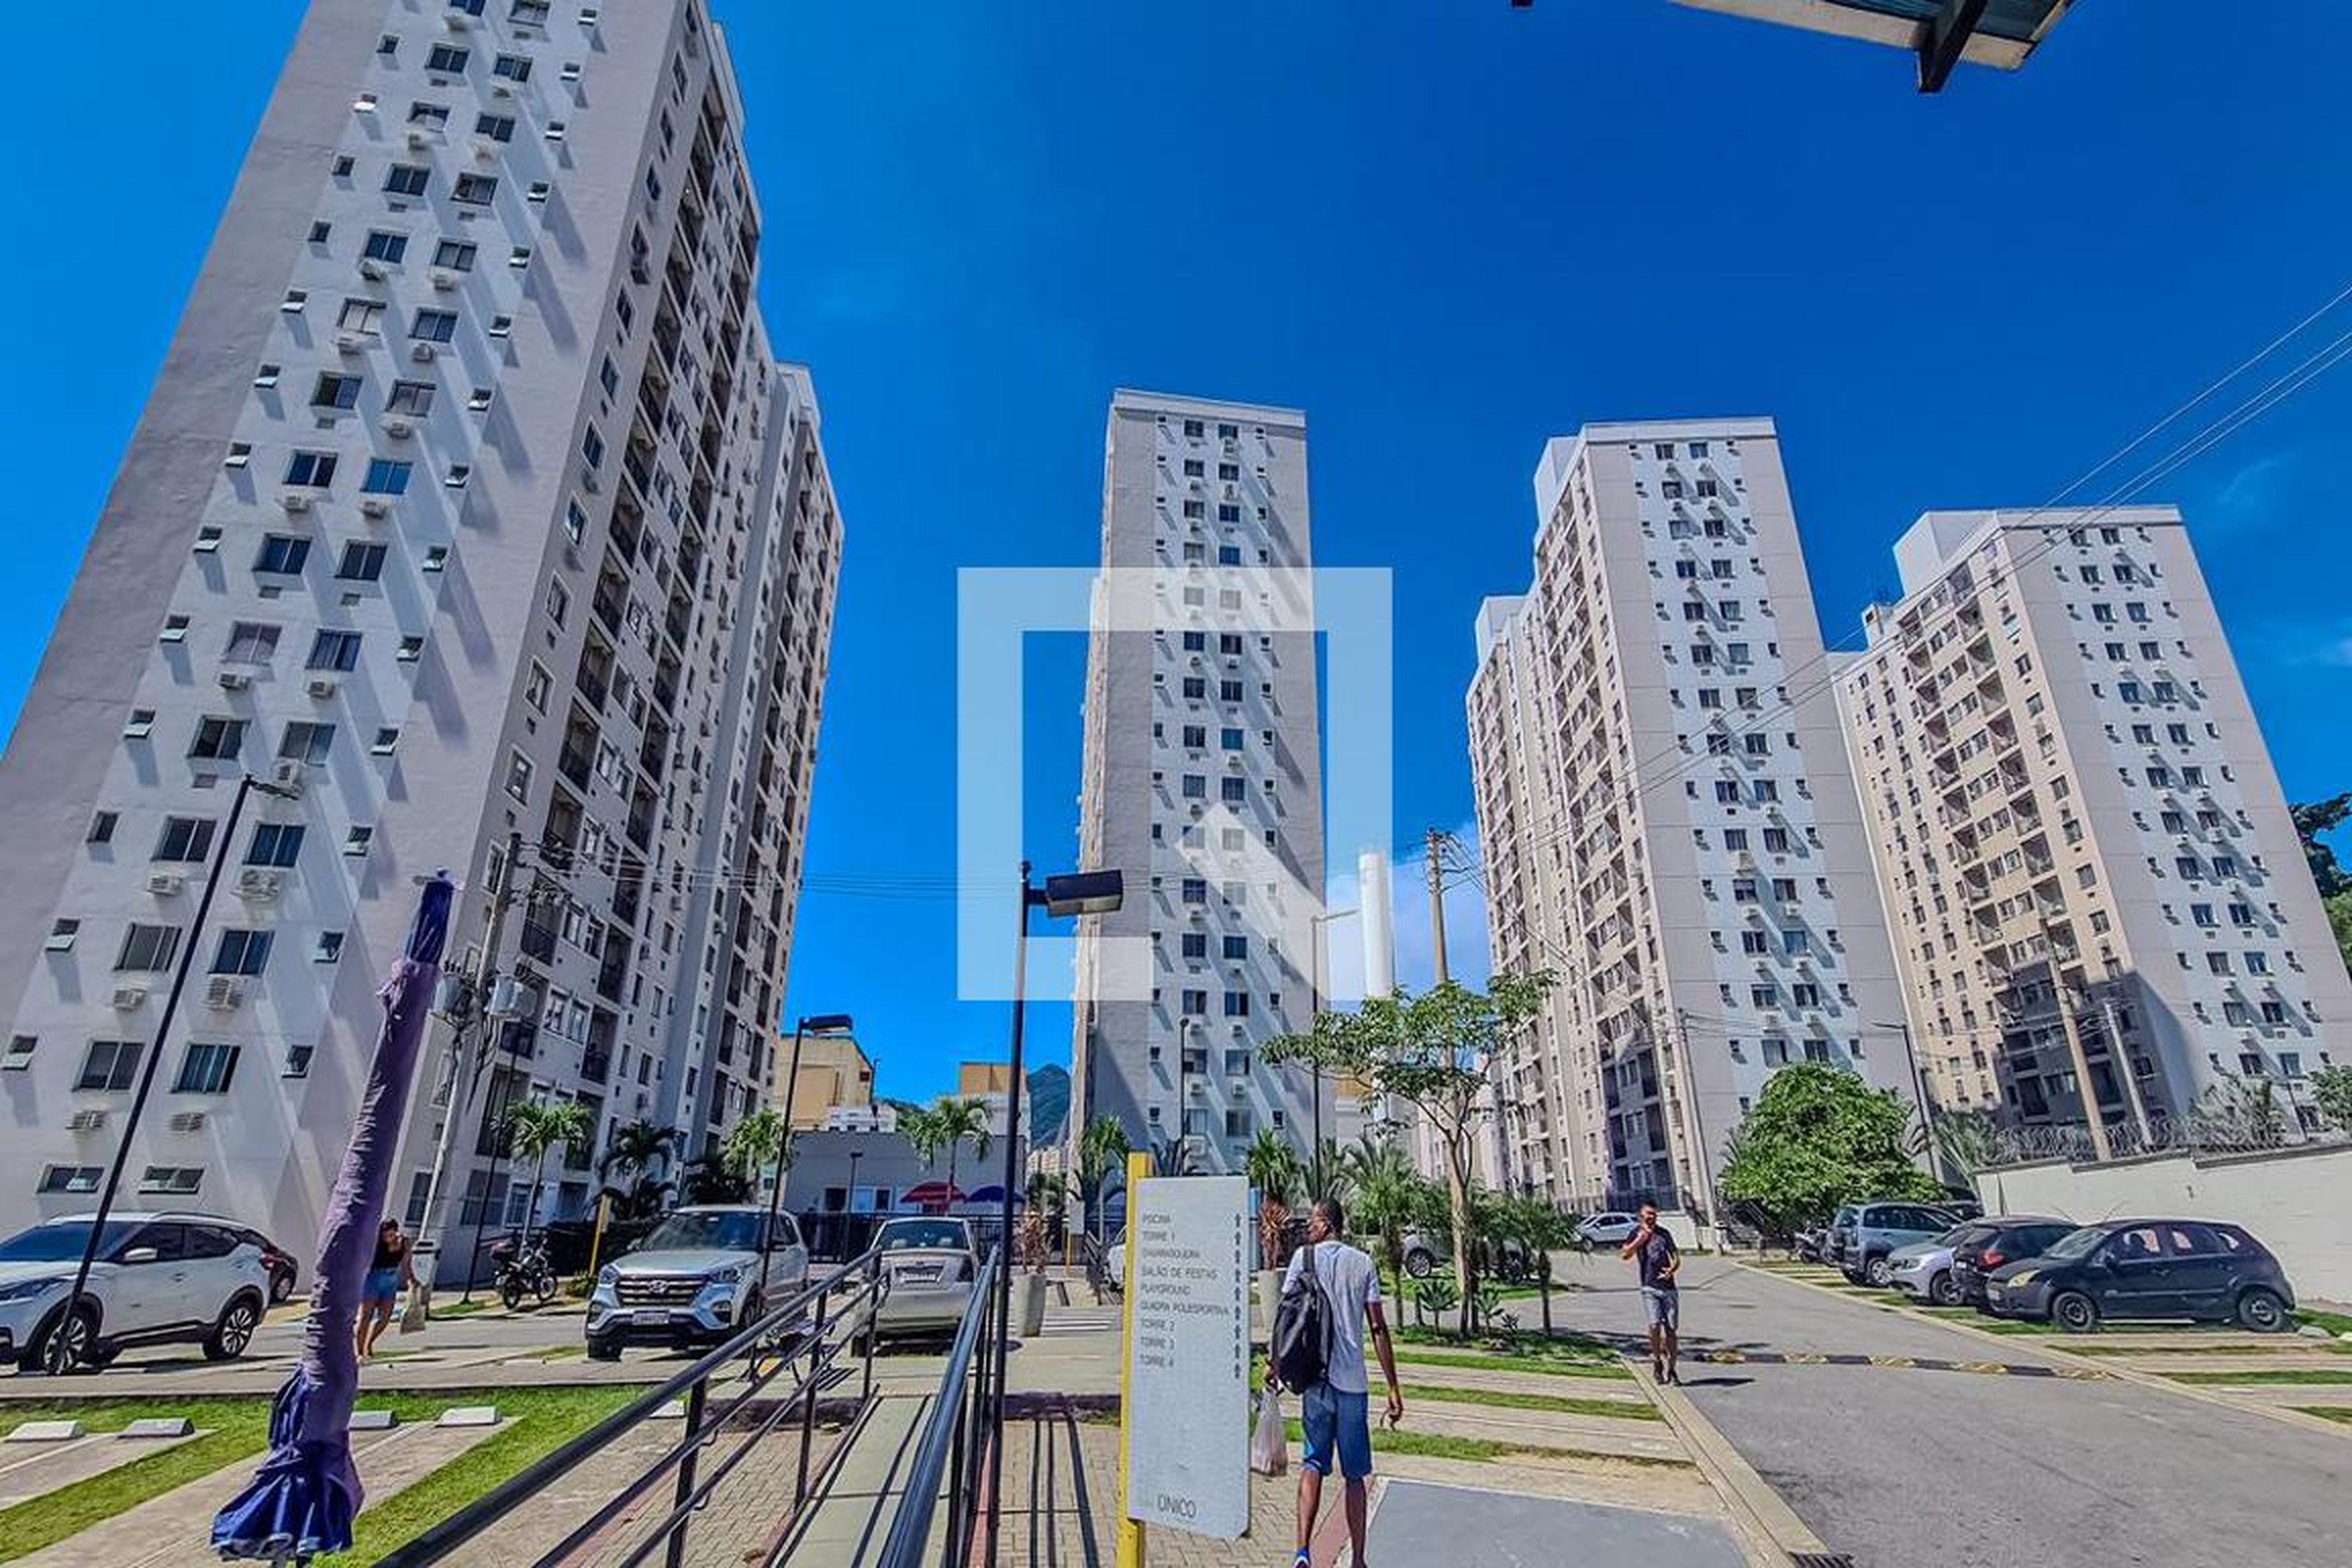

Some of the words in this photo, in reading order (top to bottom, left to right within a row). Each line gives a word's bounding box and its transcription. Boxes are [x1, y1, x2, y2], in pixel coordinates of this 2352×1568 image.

[1170, 1267, 1182, 1278] DE
[1186, 1267, 1218, 1280] FESTAS
[1141, 1283, 1190, 1295] PLAYGROUND
[1141, 1300, 1170, 1311] QUADRA
[1140, 1318, 1165, 1330] TORRE
[1169, 1320, 1175, 1332] 2
[1140, 1336, 1166, 1349] TORRE
[1140, 1354, 1164, 1367] TORRE
